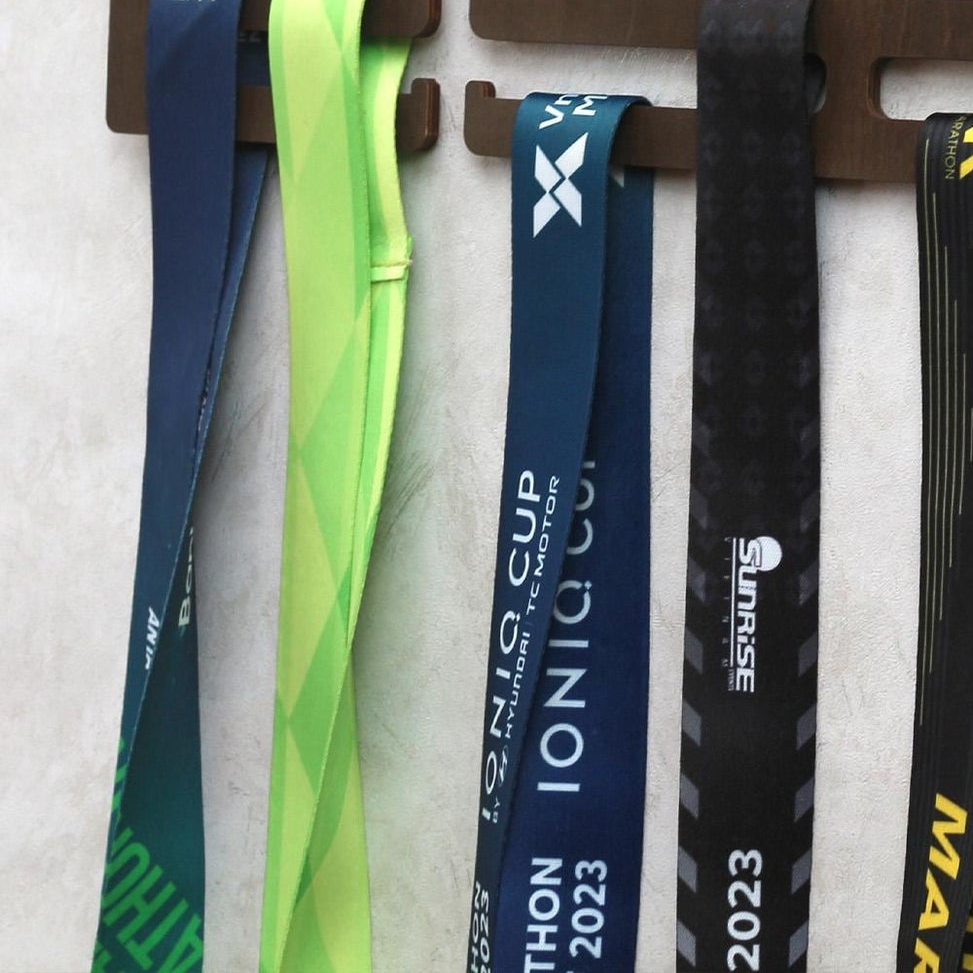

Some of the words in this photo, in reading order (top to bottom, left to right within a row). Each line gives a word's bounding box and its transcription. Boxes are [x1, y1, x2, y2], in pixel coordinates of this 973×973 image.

[943, 115, 967, 180] RATHON
[533, 475, 560, 577] MOTOR
[481, 609, 521, 821] IONIQ
[508, 469, 541, 587] CUP
[536, 579, 593, 793] IONIQ
[568, 859, 608, 959] 2023
[726, 849, 763, 972] 2023
